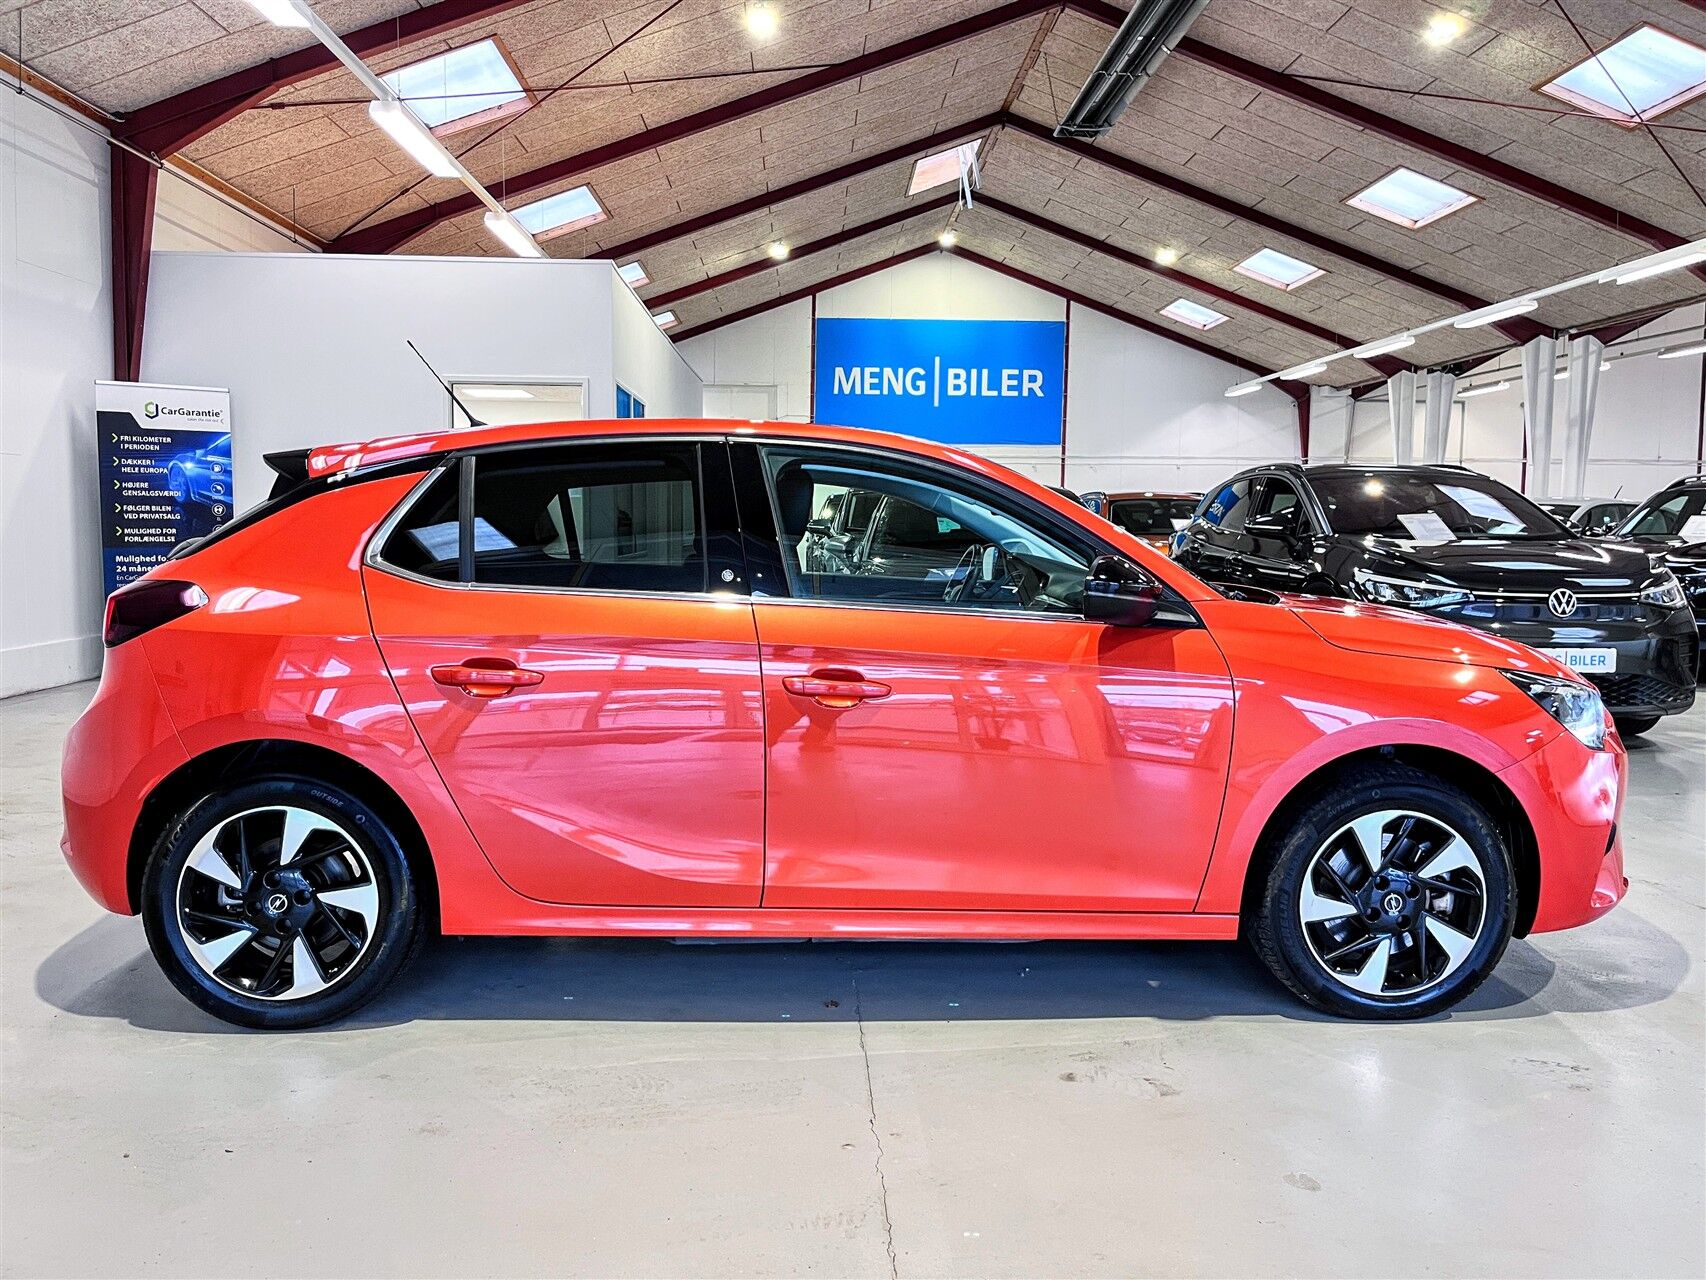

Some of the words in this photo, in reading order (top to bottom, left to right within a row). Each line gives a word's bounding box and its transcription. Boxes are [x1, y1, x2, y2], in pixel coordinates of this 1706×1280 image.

[833, 366, 926, 396] MENG
[947, 367, 1044, 397] BILER
[115, 555, 156, 563] Mulighed
[1570, 655, 1606, 666] BILER
[310, 789, 344, 808] OUTSIDE
